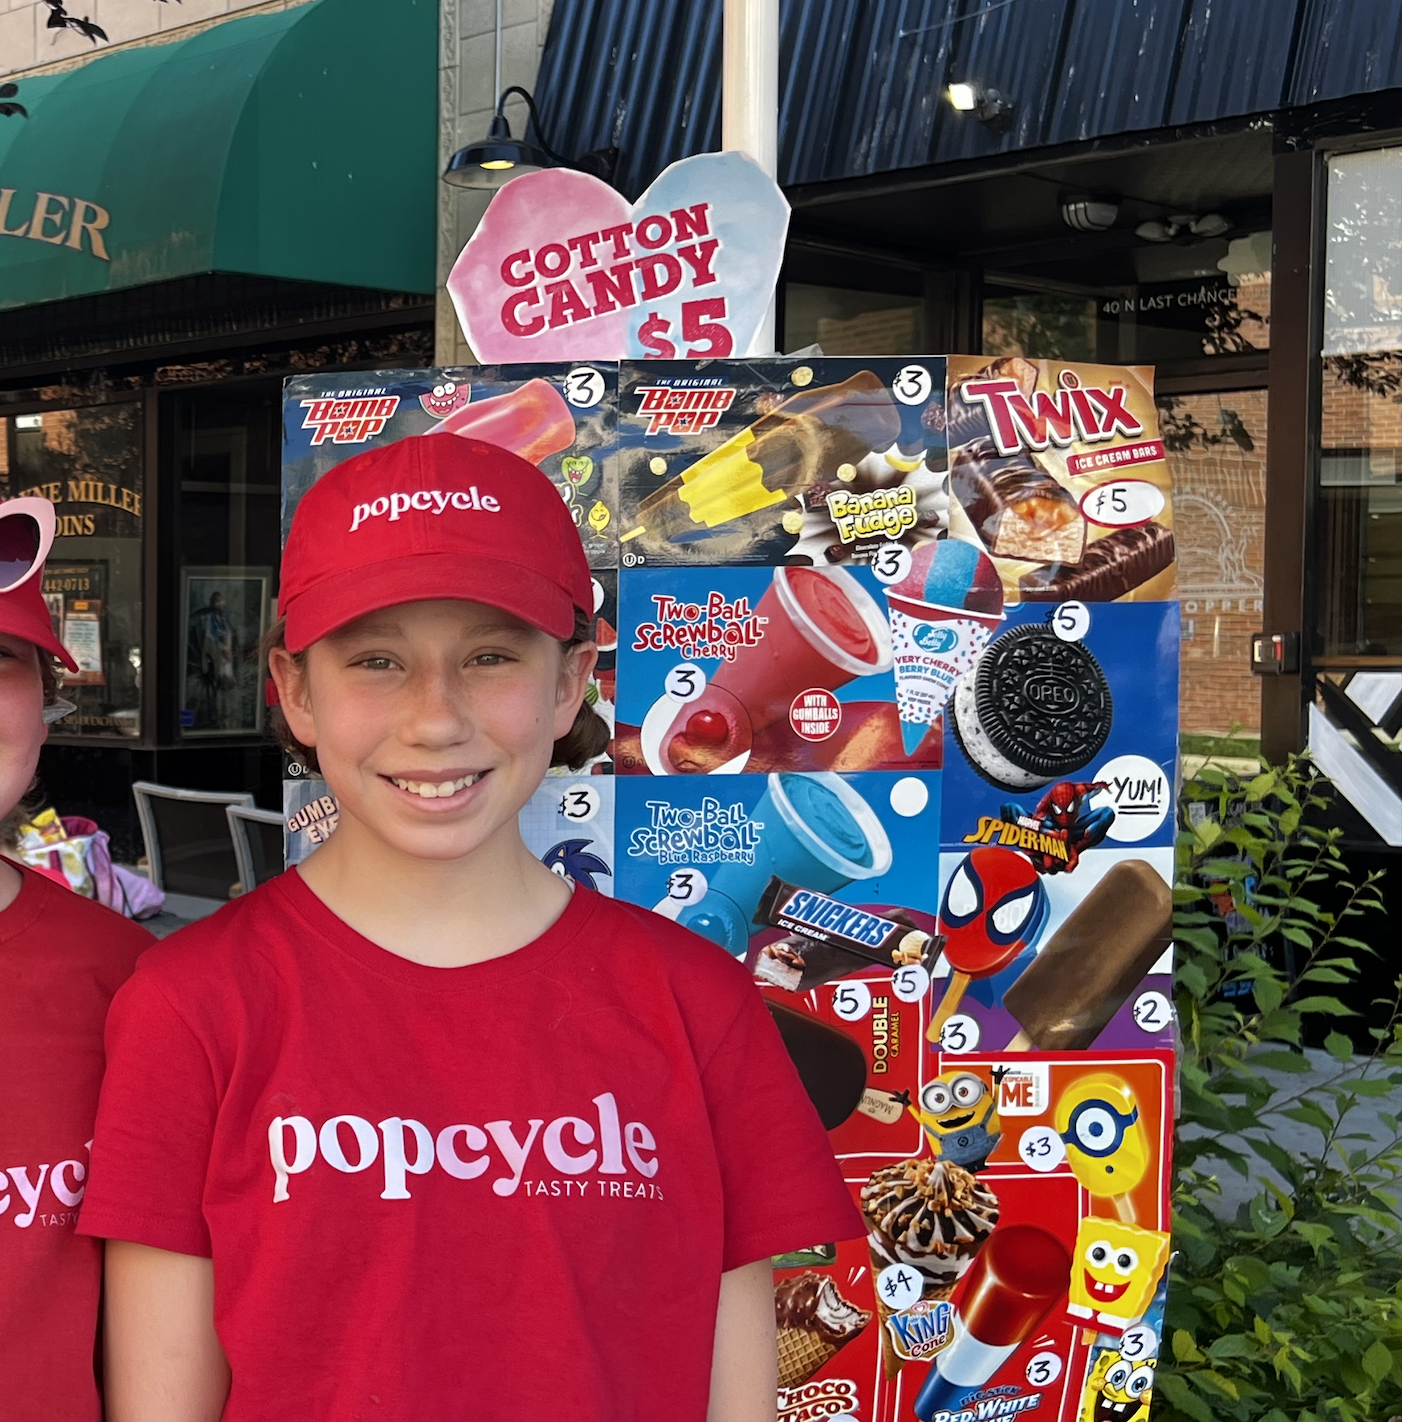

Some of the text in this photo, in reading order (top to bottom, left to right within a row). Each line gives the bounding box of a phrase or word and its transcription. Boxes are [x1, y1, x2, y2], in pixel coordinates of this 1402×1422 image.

[500, 202, 712, 288] COTTON
[500, 239, 720, 338] CANDY
[1103, 300, 1120, 314] 40
[1125, 299, 1135, 311] N
[1140, 295, 1173, 311] LAST
[1177, 288, 1237, 307] CHANCE
[637, 297, 734, 359] $5
[338, 387, 387, 398] ORIGINAL
[673, 378, 723, 387] ORIGINAL
[300, 396, 399, 421] BOMB
[635, 387, 736, 411] BOMB
[301, 419, 386, 445] POP
[636, 411, 722, 435] POP
[1075, 445, 1157, 470] ICE CREAM BARS
[348, 485, 501, 533] popcycle
[827, 485, 915, 519] Banana
[1095, 488, 1127, 515] $5
[55, 514, 95, 537] OINS
[837, 506, 915, 541] Fudge
[651, 591, 752, 623] Two-Ball
[927, 629, 949, 640] Jelly
[895, 655, 963, 677] VERY CHERRY
[899, 665, 955, 684] BERRY BLUE
[671, 670, 695, 697] 3
[1028, 686, 1075, 703] OREO
[803, 694, 827, 707] WITH
[792, 707, 838, 721] GUMBALLS
[801, 722, 830, 734] INSIDE
[1113, 777, 1161, 804] YUM!
[288, 795, 339, 833] GUMB
[646, 797, 747, 828] Two-Ball
[1017, 816, 1041, 831] MARVEL
[777, 918, 828, 941] ICE CREAM
[783, 891, 895, 946] SNICKERS
[873, 996, 888, 1073] DOUBLE
[891, 1012, 899, 1057] CARAMEL
[1001, 1083, 1033, 1107] ME
[268, 1092, 659, 1203] popcycle
[1025, 1137, 1051, 1157] $3
[524, 1180, 664, 1200] TASTY TREATS
[885, 1270, 912, 1297] $4
[890, 1302, 950, 1351] KING
[911, 1335, 946, 1357] Cone
[778, 1401, 840, 1422] TACO
[977, 1393, 1042, 1420] WHITE
